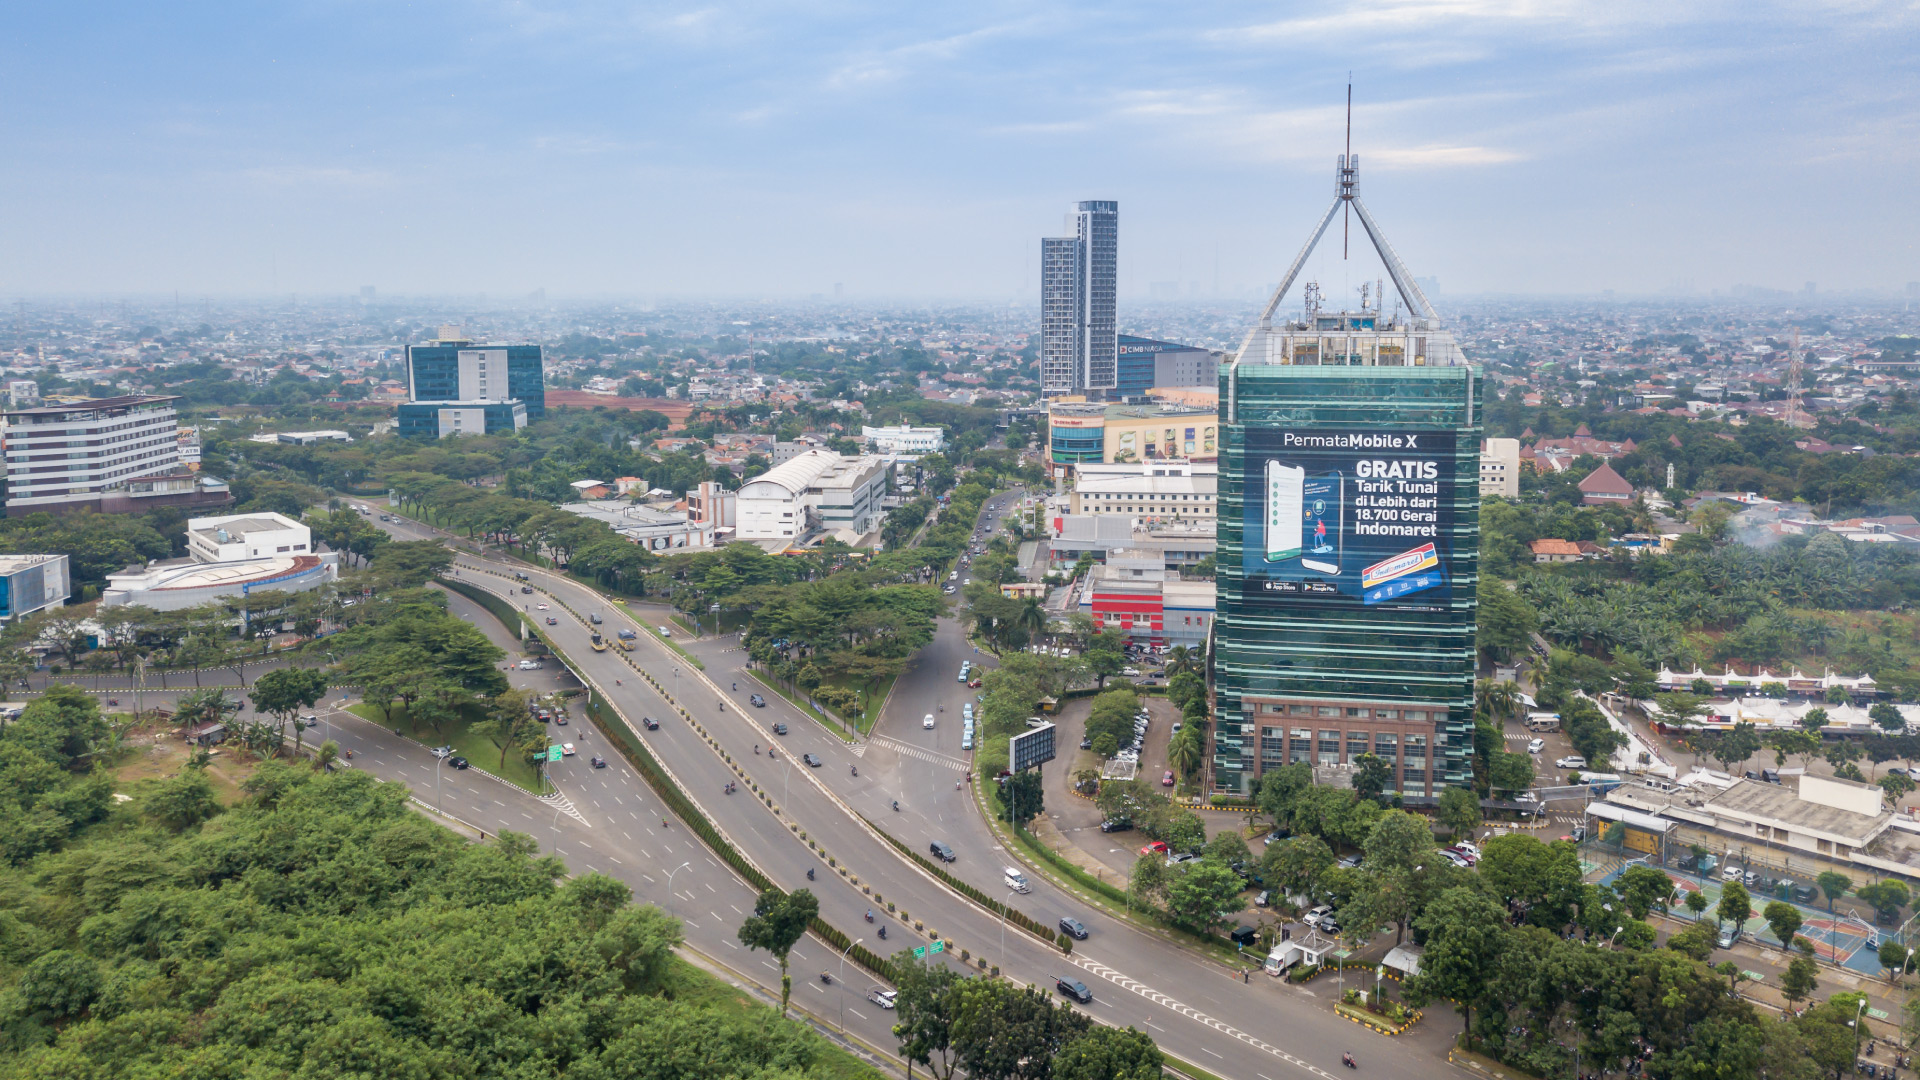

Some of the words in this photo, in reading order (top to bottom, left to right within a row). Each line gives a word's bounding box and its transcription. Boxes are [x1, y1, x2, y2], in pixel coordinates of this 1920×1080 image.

[1144, 345, 1163, 353] NIAGA
[1284, 433, 1402, 448] PermataMobile
[1405, 435, 1418, 448] X
[1356, 460, 1438, 479] GRATIS
[1355, 479, 1393, 493] Tarik
[1397, 480, 1438, 494] Tunai
[1356, 495, 1368, 507] di
[1370, 495, 1407, 508] Lebih
[1410, 497, 1437, 508] dari
[1355, 509, 1398, 521] 18.700
[1401, 510, 1437, 522] Gerai
[1355, 522, 1437, 537] Indomaret
[1374, 556, 1419, 578] Indomaret
